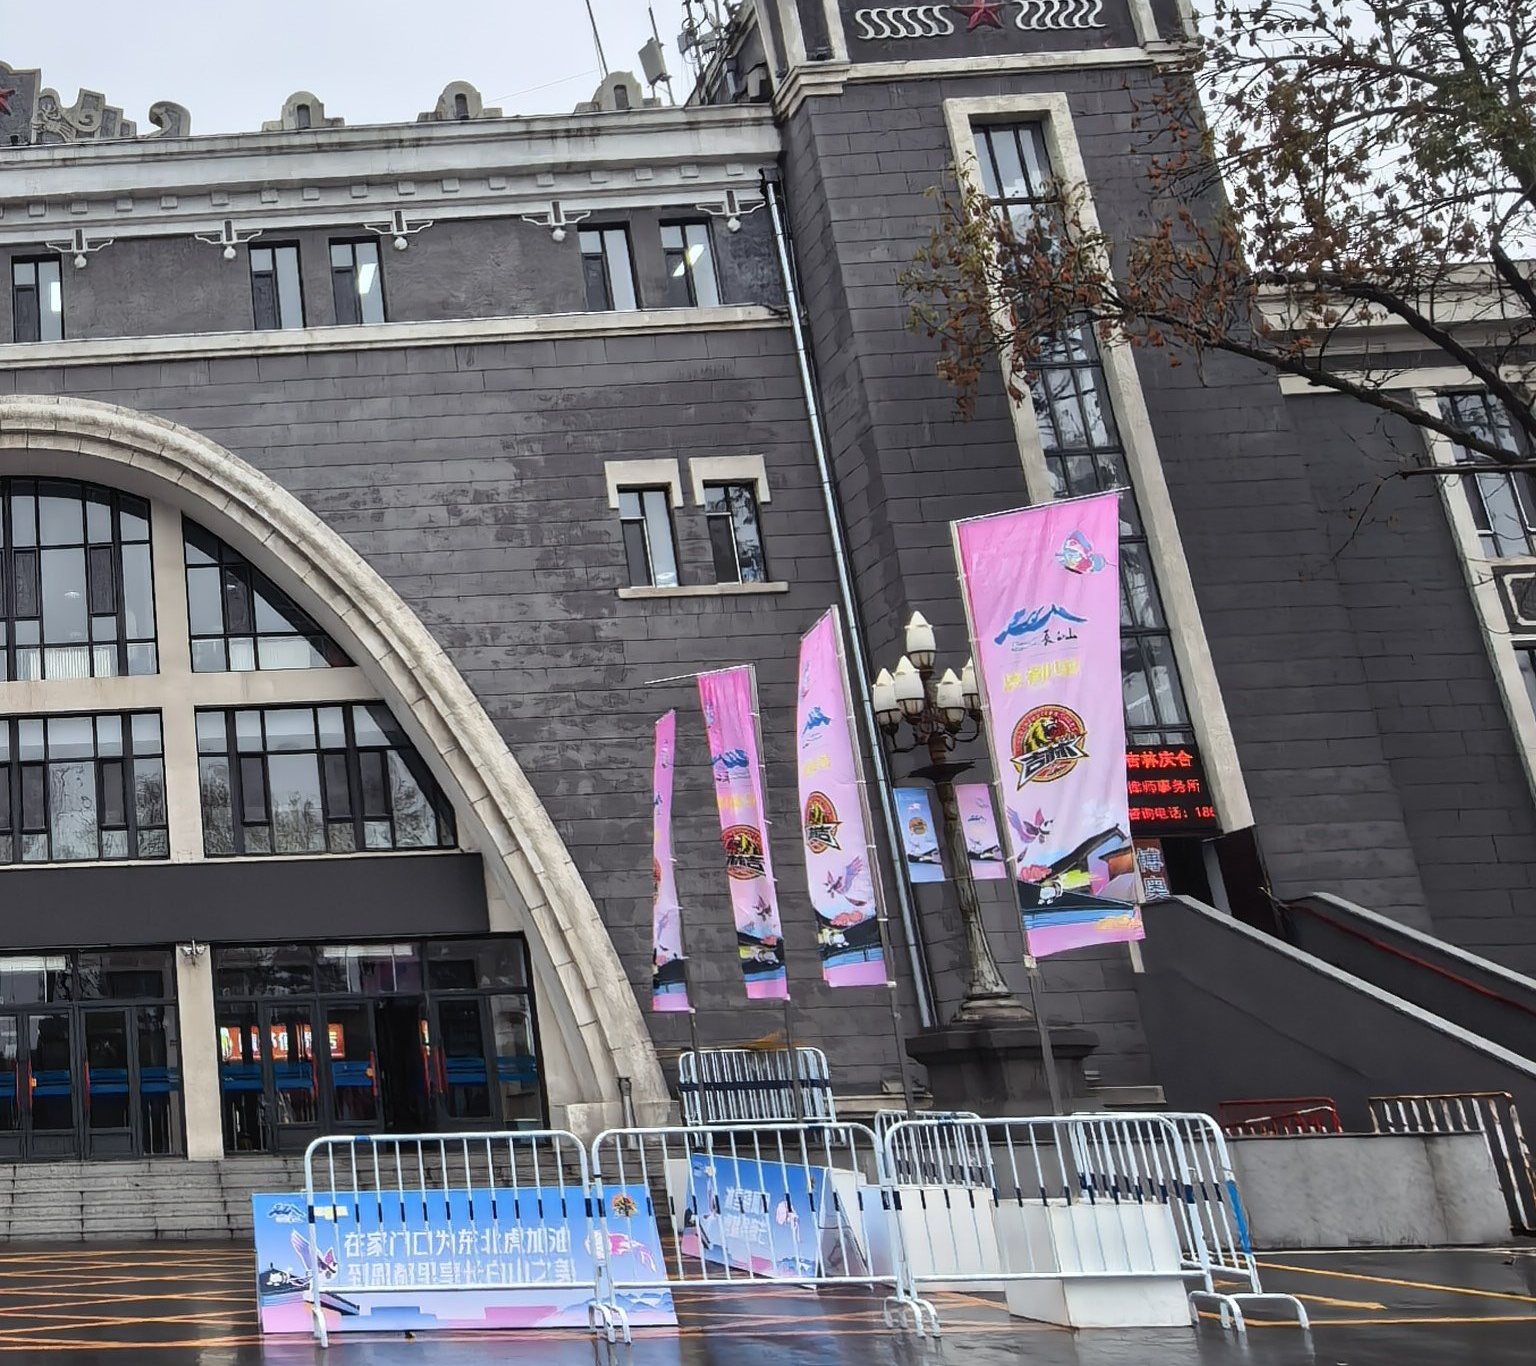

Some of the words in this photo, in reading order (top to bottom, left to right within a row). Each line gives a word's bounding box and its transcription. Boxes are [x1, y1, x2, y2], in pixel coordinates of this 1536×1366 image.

[1128, 778, 1200, 795] 律师事务所
[344, 1225, 572, 1257] 在家门口为东北虎加油
